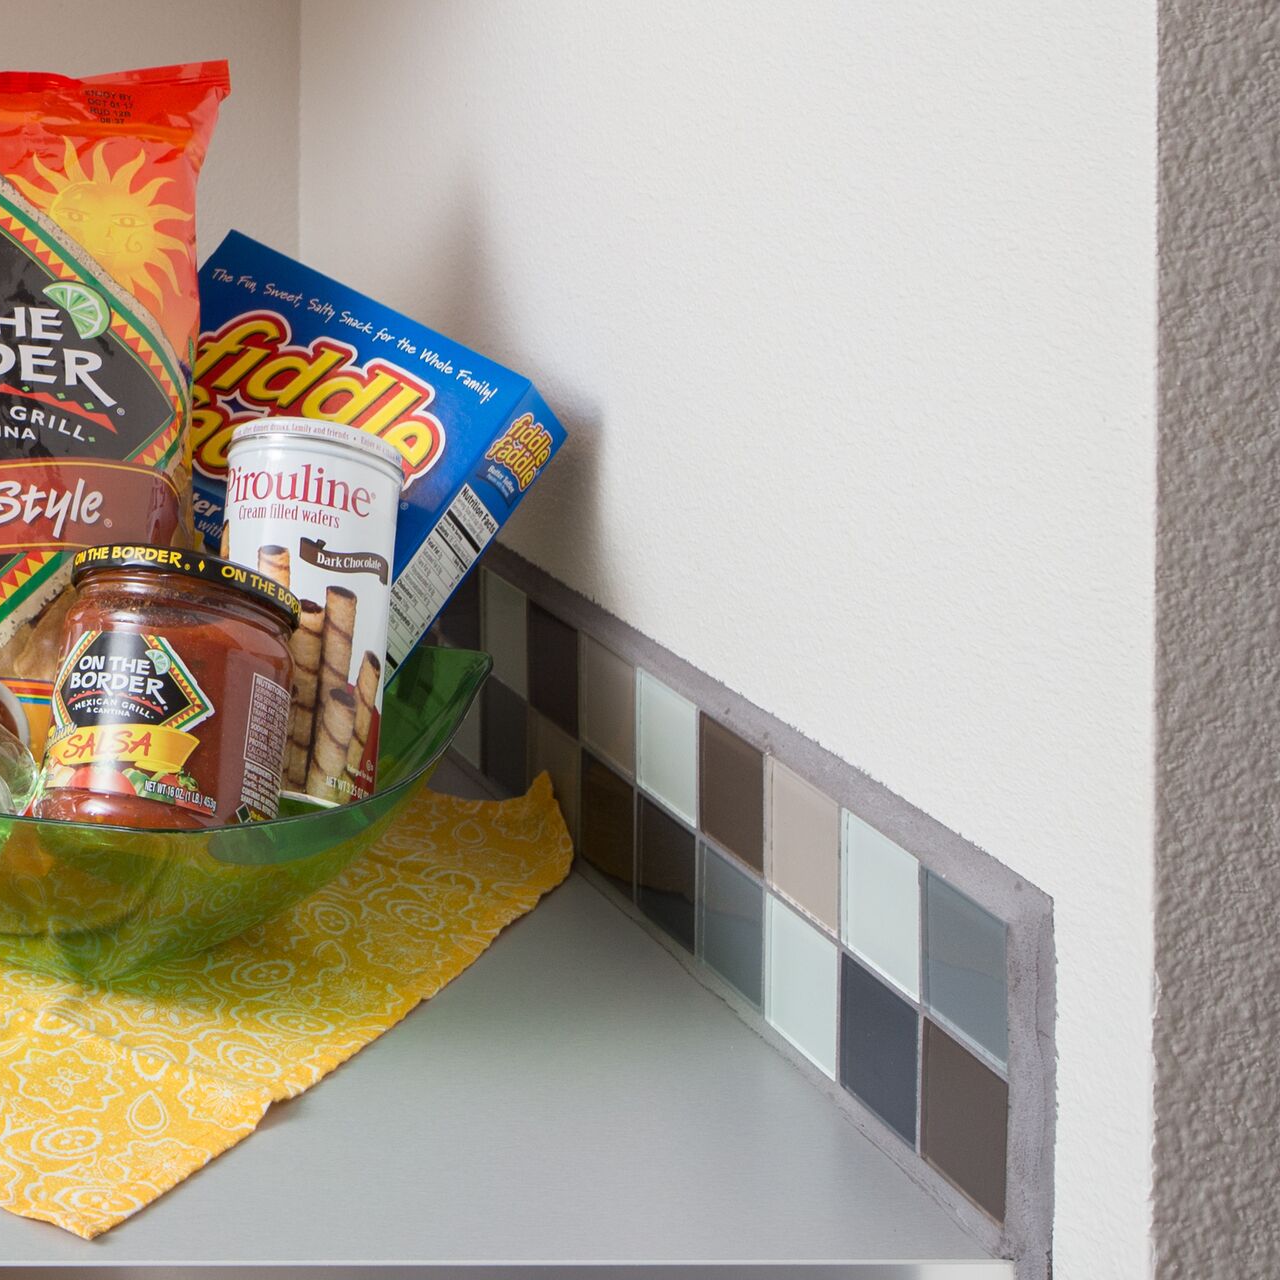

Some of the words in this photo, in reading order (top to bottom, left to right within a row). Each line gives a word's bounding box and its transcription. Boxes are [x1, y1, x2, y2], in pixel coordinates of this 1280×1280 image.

[212, 268, 234, 283] The
[236, 275, 257, 293] Fun,
[263, 283, 304, 308] Sweet,
[307, 298, 336, 323] Salty
[338, 310, 374, 335] Snack
[372, 327, 395, 343] for
[397, 337, 417, 355] the
[419, 348, 453, 375] Whole
[455, 369, 498, 405] Family!
[193, 319, 433, 468] fiddle
[9, 404, 86, 442] GRILL
[291, 423, 312, 434] family
[312, 425, 326, 434] and
[326, 426, 349, 440] friends
[507, 414, 552, 467] fiddle
[485, 438, 536, 491] faddle
[225, 463, 371, 517] Pirouline
[239, 504, 267, 521] Cream
[269, 503, 298, 521] filled
[302, 509, 340, 529] wafers
[461, 486, 483, 519] Nutrition
[481, 513, 496, 535] Facts
[74, 548, 87, 566] ON
[88, 545, 108, 560] THE
[111, 545, 183, 569] BORDER
[316, 551, 342, 568] Dark
[343, 556, 382, 570] Chocolate
[221, 565, 246, 584] ON
[249, 575, 276, 598] THE
[79, 655, 106, 671] ON
[108, 656, 151, 676] THE
[69, 671, 167, 707] BORDER
[74, 697, 118, 711] MEXICAN
[121, 698, 151, 719] GRILL
[93, 706, 131, 718] CANTINA
[63, 730, 152, 760] SALSA
[144, 780, 157, 793] NET
[167, 785, 175, 797] 16
